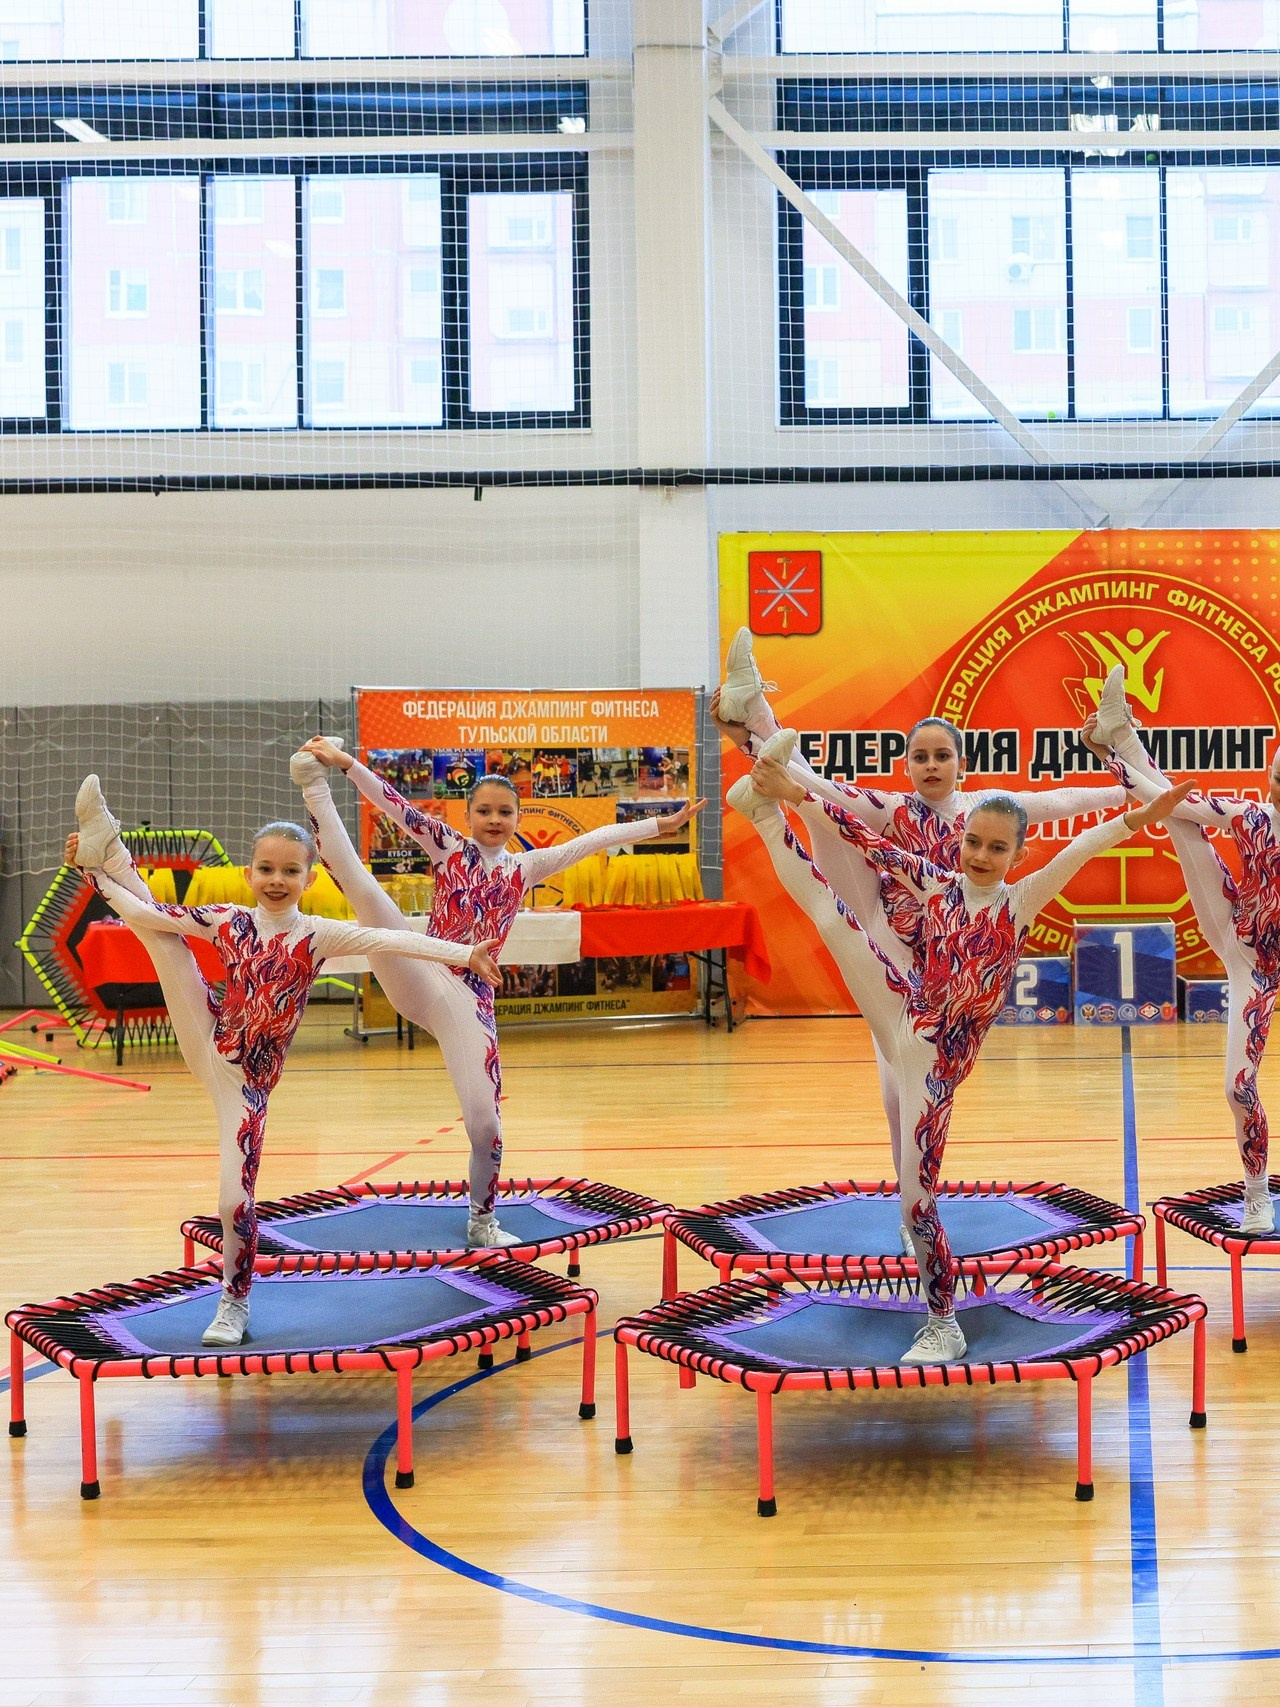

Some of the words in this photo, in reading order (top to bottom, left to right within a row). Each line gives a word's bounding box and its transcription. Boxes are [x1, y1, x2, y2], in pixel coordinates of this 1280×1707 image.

[941, 625, 1013, 728] ДЕРАЦИЯ
[1015, 581, 1159, 634] ДЖАМПИНГ
[1167, 589, 1269, 664] ФИТНЕСА
[402, 700, 496, 720] ФЕДЕРАЦИЯ
[500, 700, 587, 720] ДЖАМПИНГ
[591, 700, 659, 719] ФИТНЕСА
[458, 723, 537, 743] ТУЛЬСКОЙ
[541, 725, 608, 743] ОБЛАСТИ
[799, 730, 1018, 781] ЕДЕРИЯ
[1031, 728, 1274, 779] ДЖМПИНГ
[548, 810, 580, 834] ФИТНЕСА
[1113, 931, 1134, 999] 1
[1016, 964, 1038, 1005] 2
[533, 1001, 584, 1014] ДЖАМПИНГ
